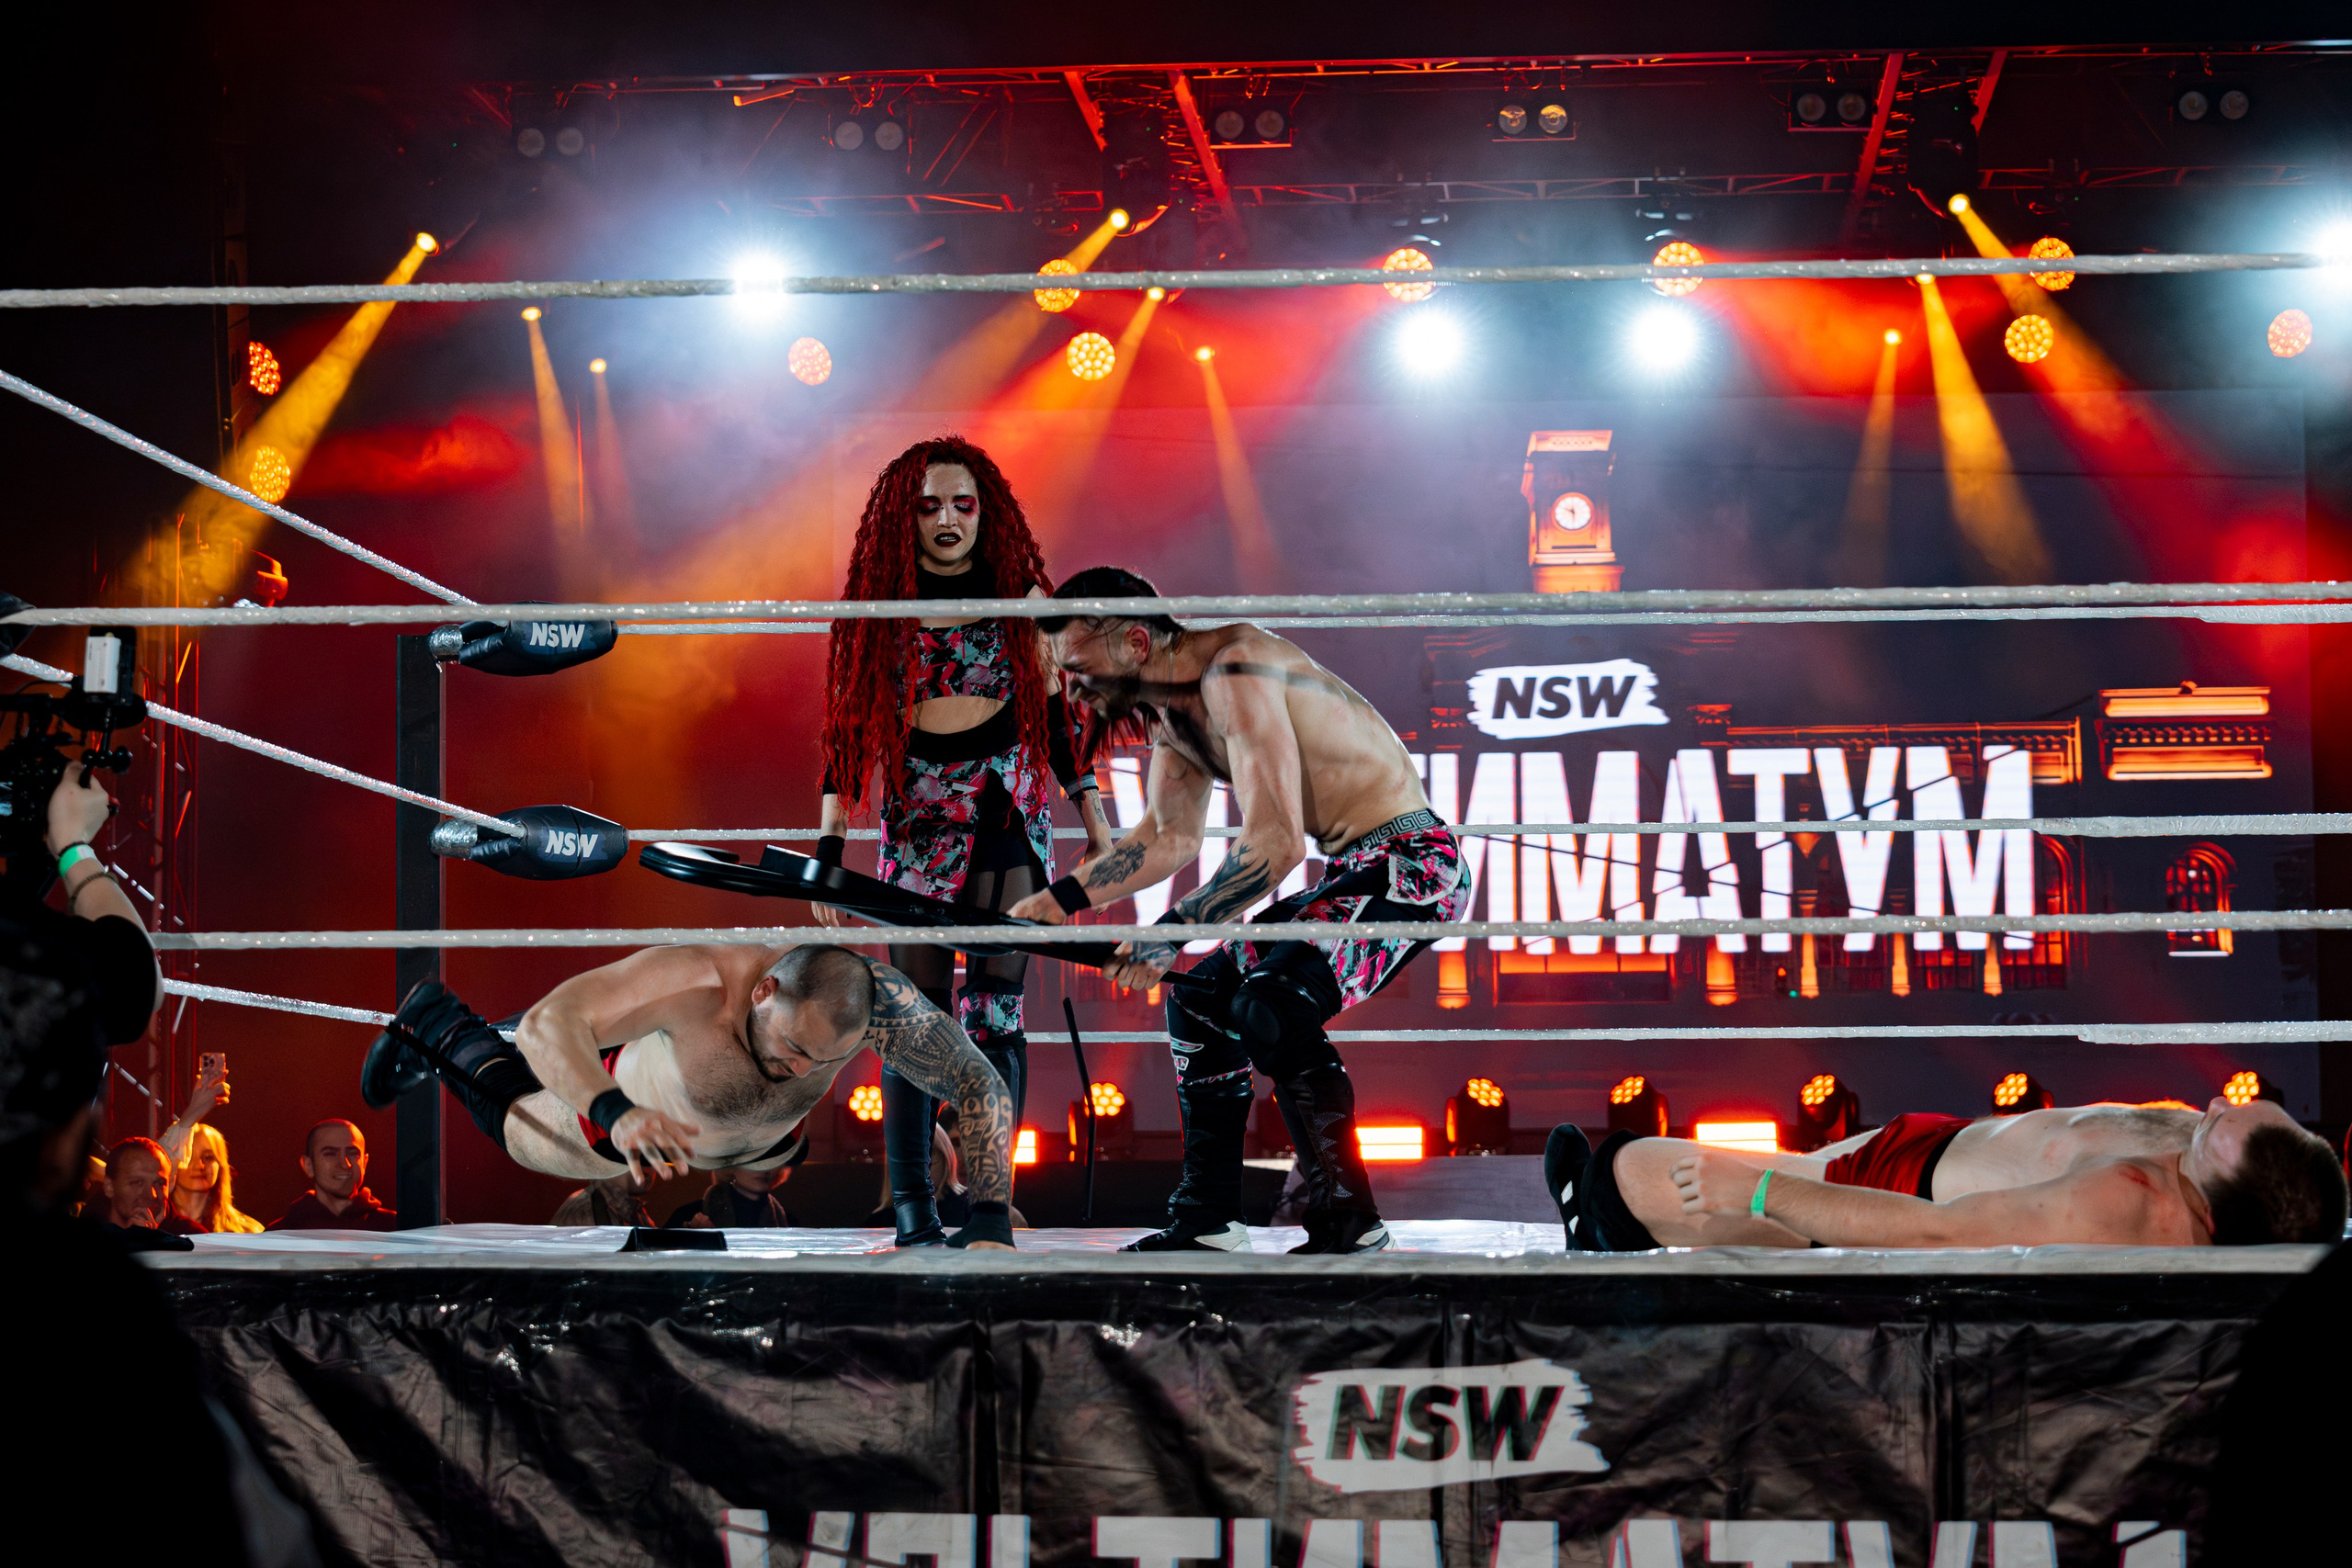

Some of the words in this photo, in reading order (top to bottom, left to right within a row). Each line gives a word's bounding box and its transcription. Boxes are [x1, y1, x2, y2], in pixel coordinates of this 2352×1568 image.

[529, 622, 585, 648] NSW
[1491, 674, 1638, 719] NSW
[545, 829, 598, 858] NSW
[1325, 1384, 1565, 1461] NSW
